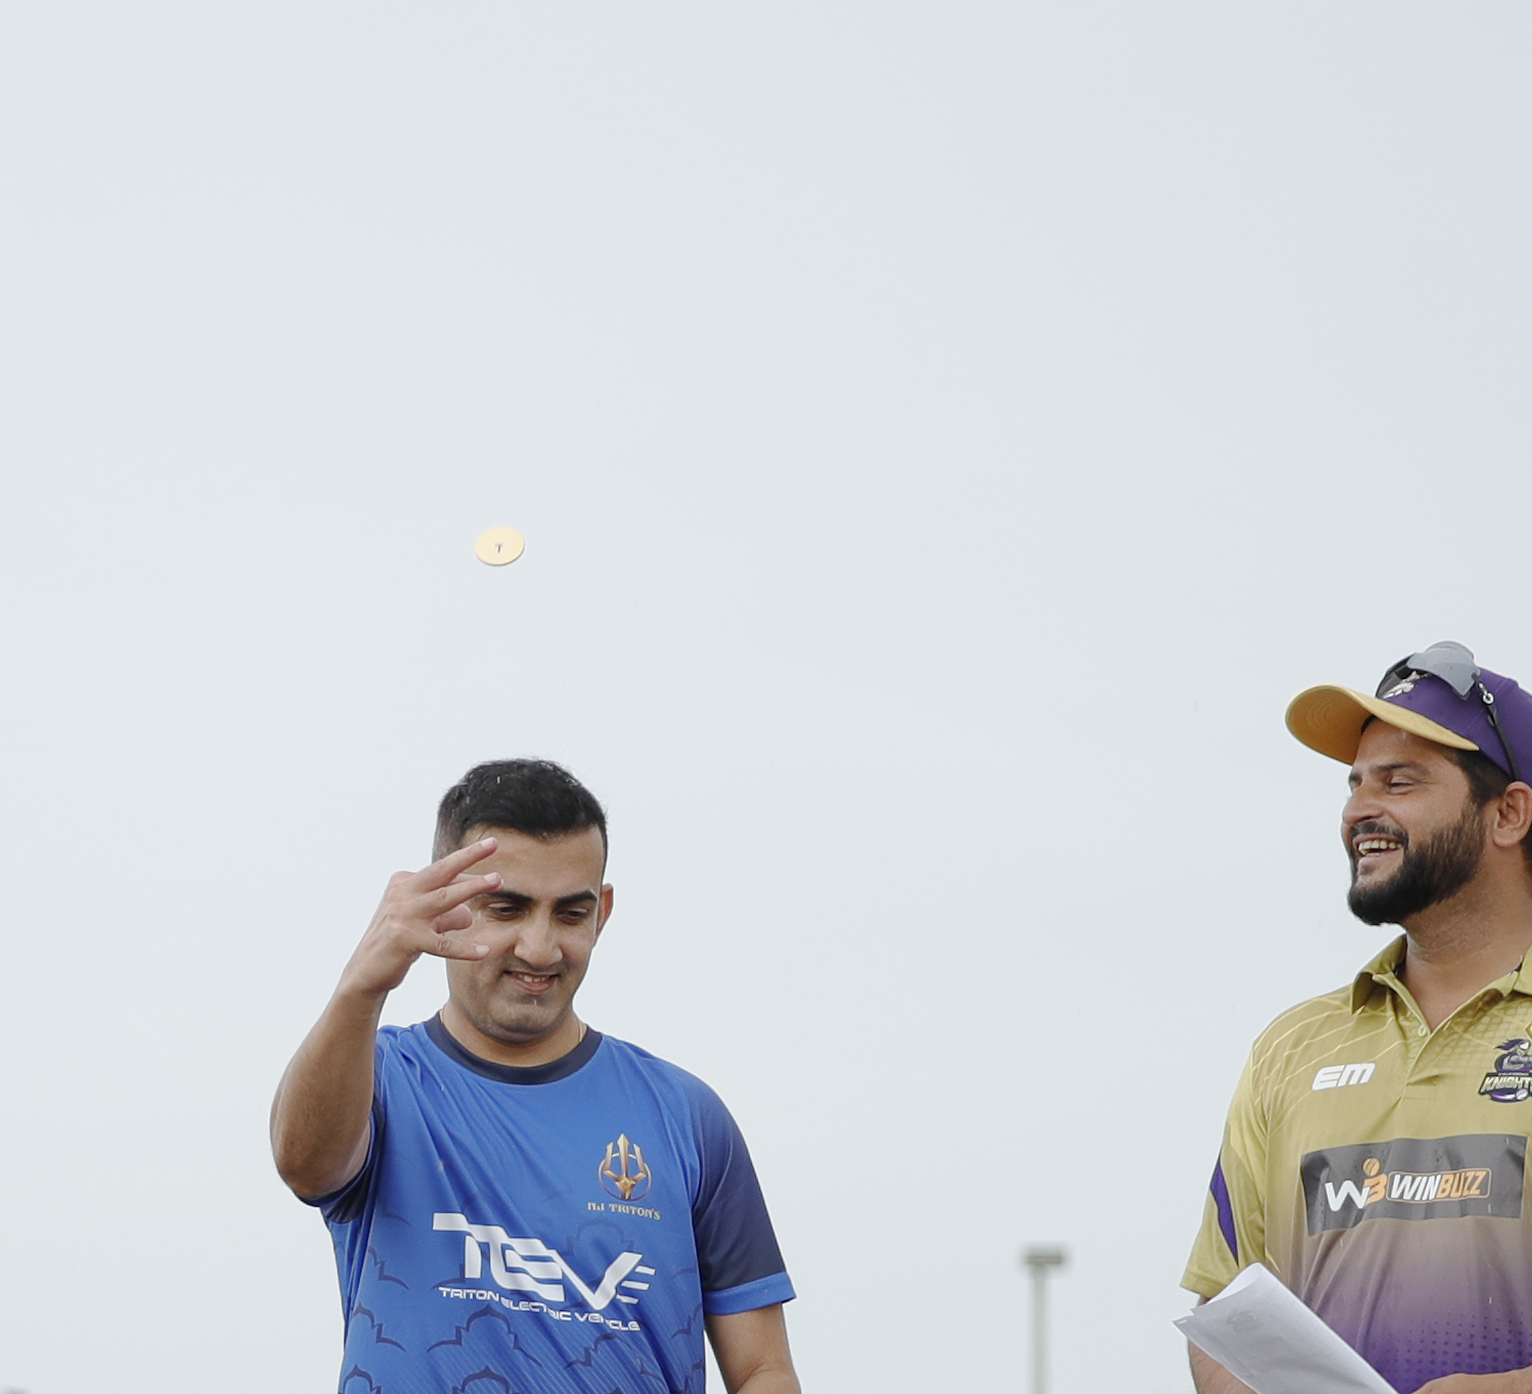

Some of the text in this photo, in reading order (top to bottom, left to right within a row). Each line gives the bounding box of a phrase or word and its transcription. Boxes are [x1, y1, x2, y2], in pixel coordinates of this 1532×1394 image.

[1390, 1171, 1487, 1201] WINBUZZ
[438, 1287, 500, 1302] TRITON
[500, 1296, 572, 1321] ELECTRIC
